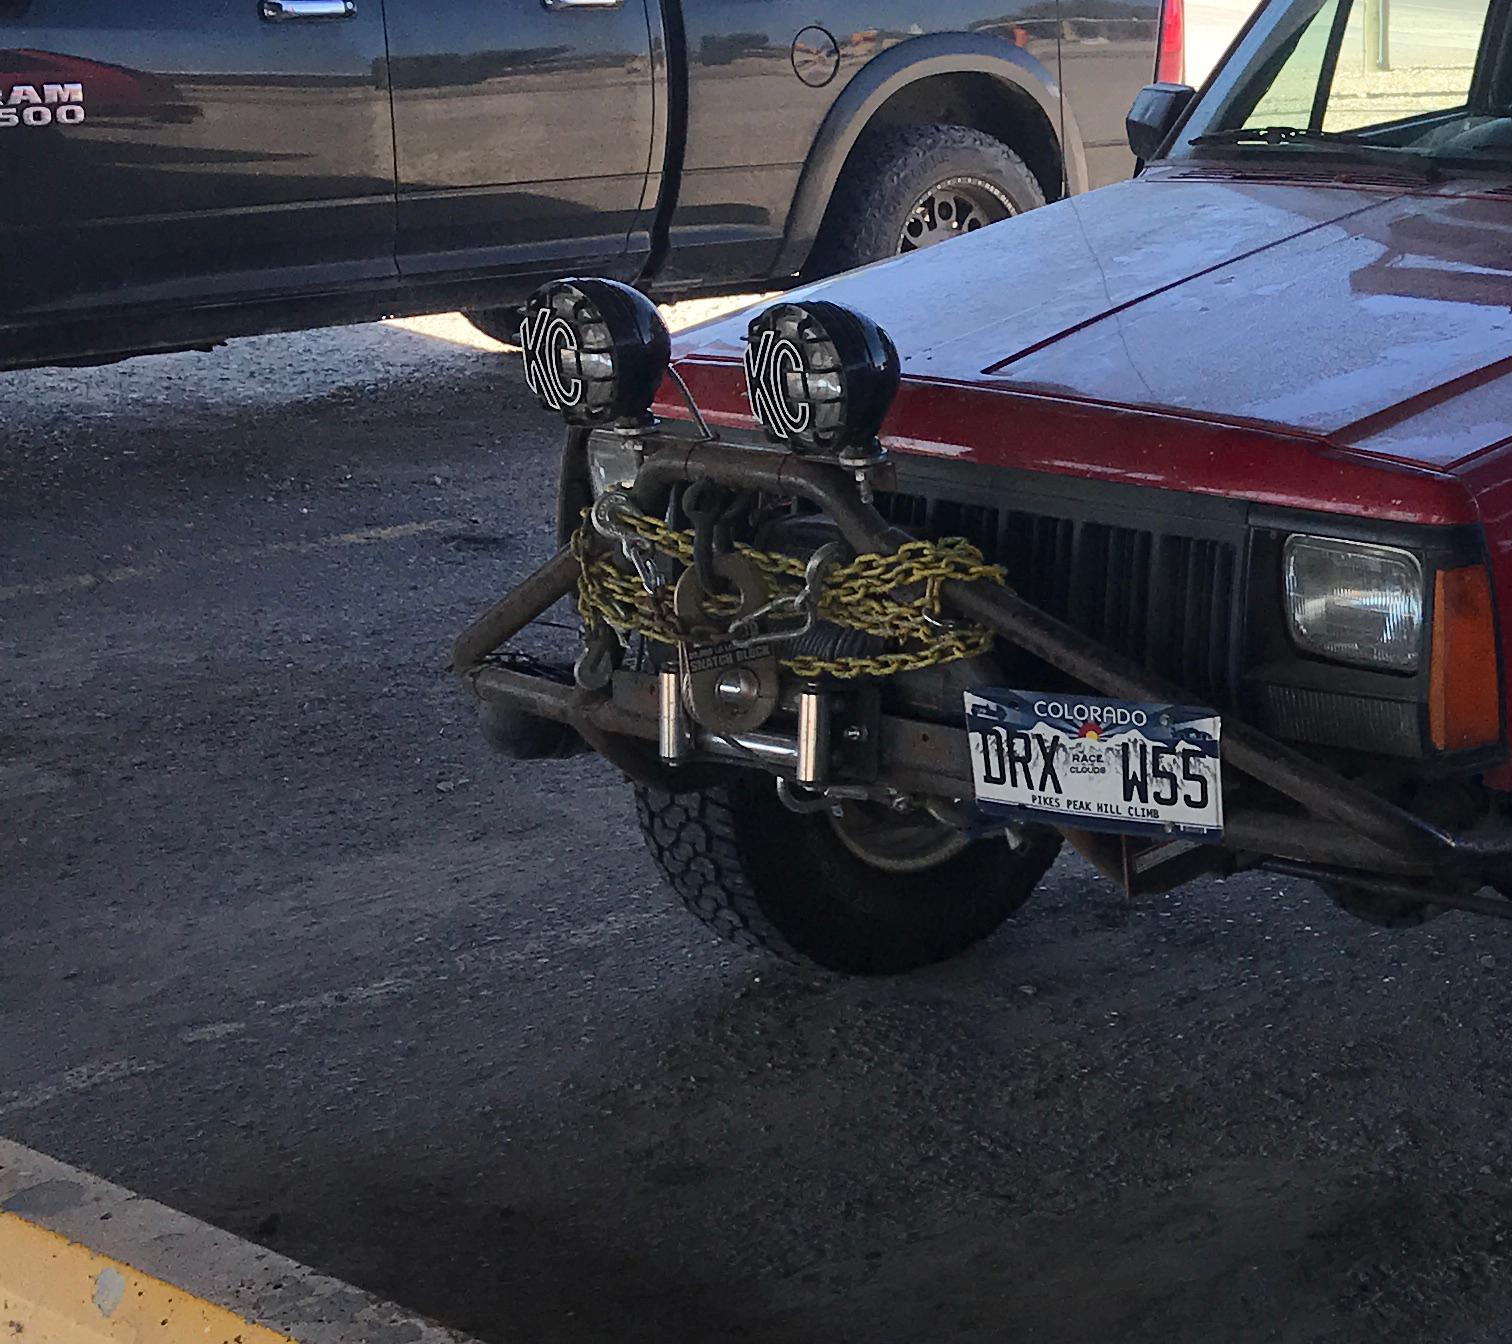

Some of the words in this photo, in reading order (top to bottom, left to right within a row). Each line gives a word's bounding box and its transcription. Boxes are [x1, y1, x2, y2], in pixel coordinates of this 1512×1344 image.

[0, 83, 83, 106] AM
[519, 307, 582, 411] KC
[743, 330, 810, 440] KC
[1034, 700, 1148, 727] COLORADO
[981, 727, 1063, 794] DRX
[1121, 741, 1209, 809] W55
[1069, 766, 1106, 775] CLOUDS
[1072, 753, 1104, 763] RACE
[1031, 794, 1061, 808] PIKES
[1066, 799, 1092, 812] PEAK
[1097, 803, 1122, 816] HILL
[1128, 806, 1160, 819] CLIMB
